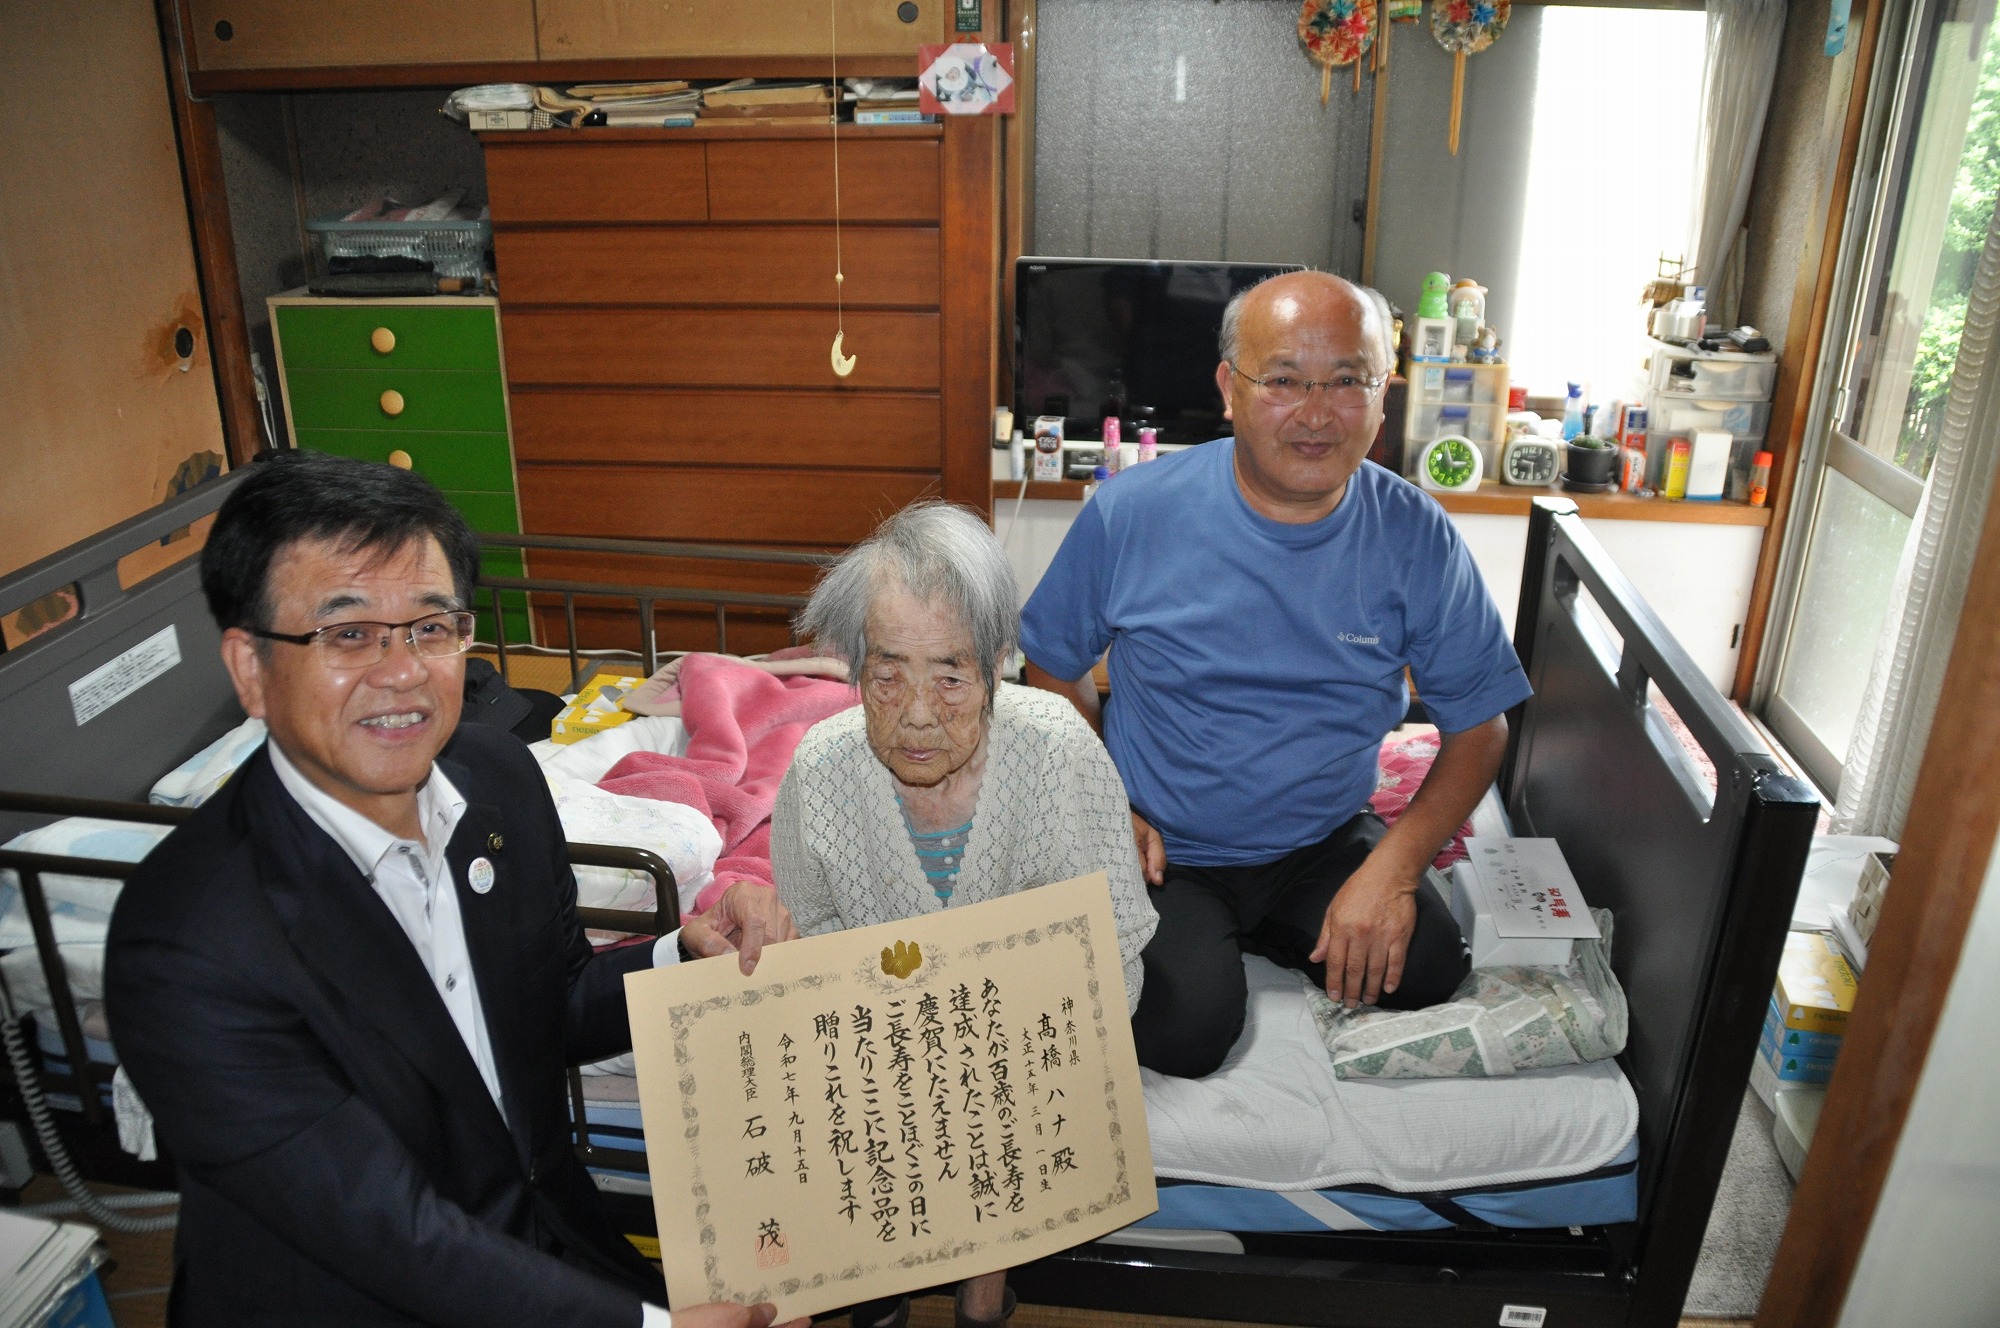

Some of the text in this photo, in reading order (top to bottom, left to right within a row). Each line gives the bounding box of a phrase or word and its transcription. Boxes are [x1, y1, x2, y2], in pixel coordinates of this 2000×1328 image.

[812, 1010, 862, 1226] 贈りこれを祝します
[850, 1004, 900, 1242] 当たりここに記念品を
[883, 1000, 932, 1238] ご長寿をことほぐこの日に
[913, 992, 960, 1182] 慶賀にたえません
[949, 983, 1000, 1223] 達成されたことは誠に
[980, 977, 1025, 1213] あなたが百歳のご長寿を
[1061, 996, 1081, 1067] 神奈川県
